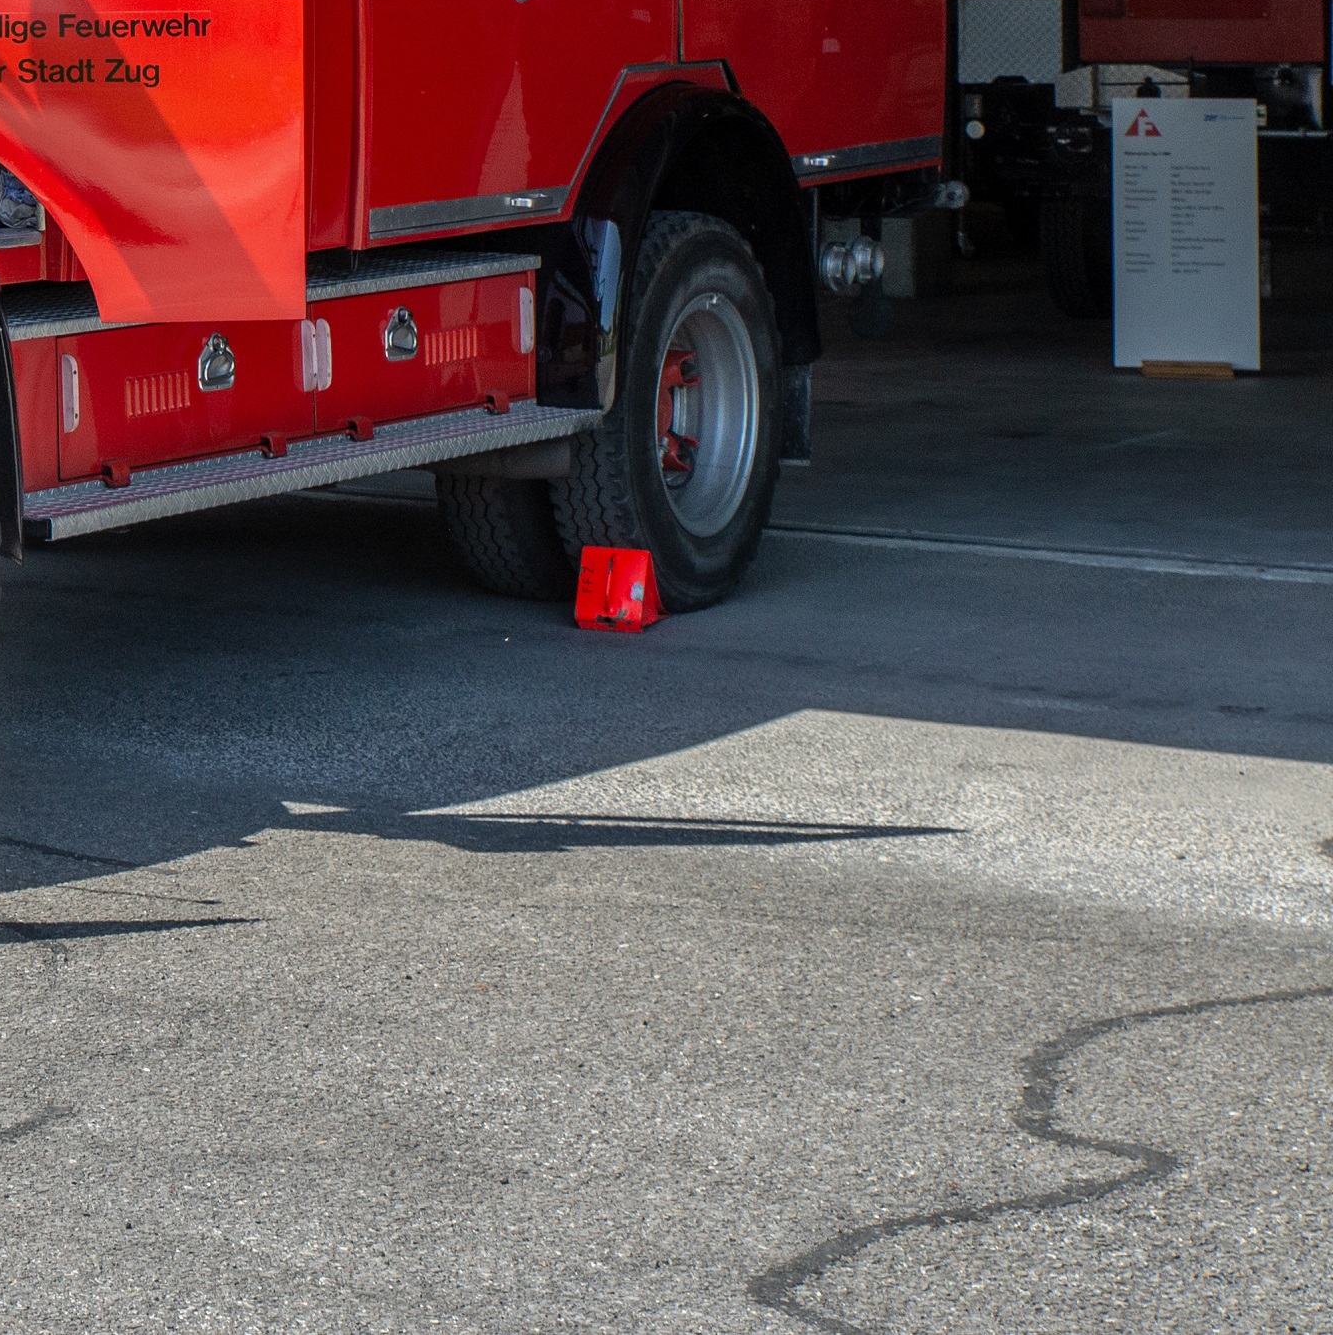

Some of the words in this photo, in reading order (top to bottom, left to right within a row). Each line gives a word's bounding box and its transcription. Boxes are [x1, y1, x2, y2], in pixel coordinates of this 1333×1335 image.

[58, 13, 212, 38] Feuerwehr
[17, 58, 95, 83] Stadt
[105, 59, 160, 88] Zug
